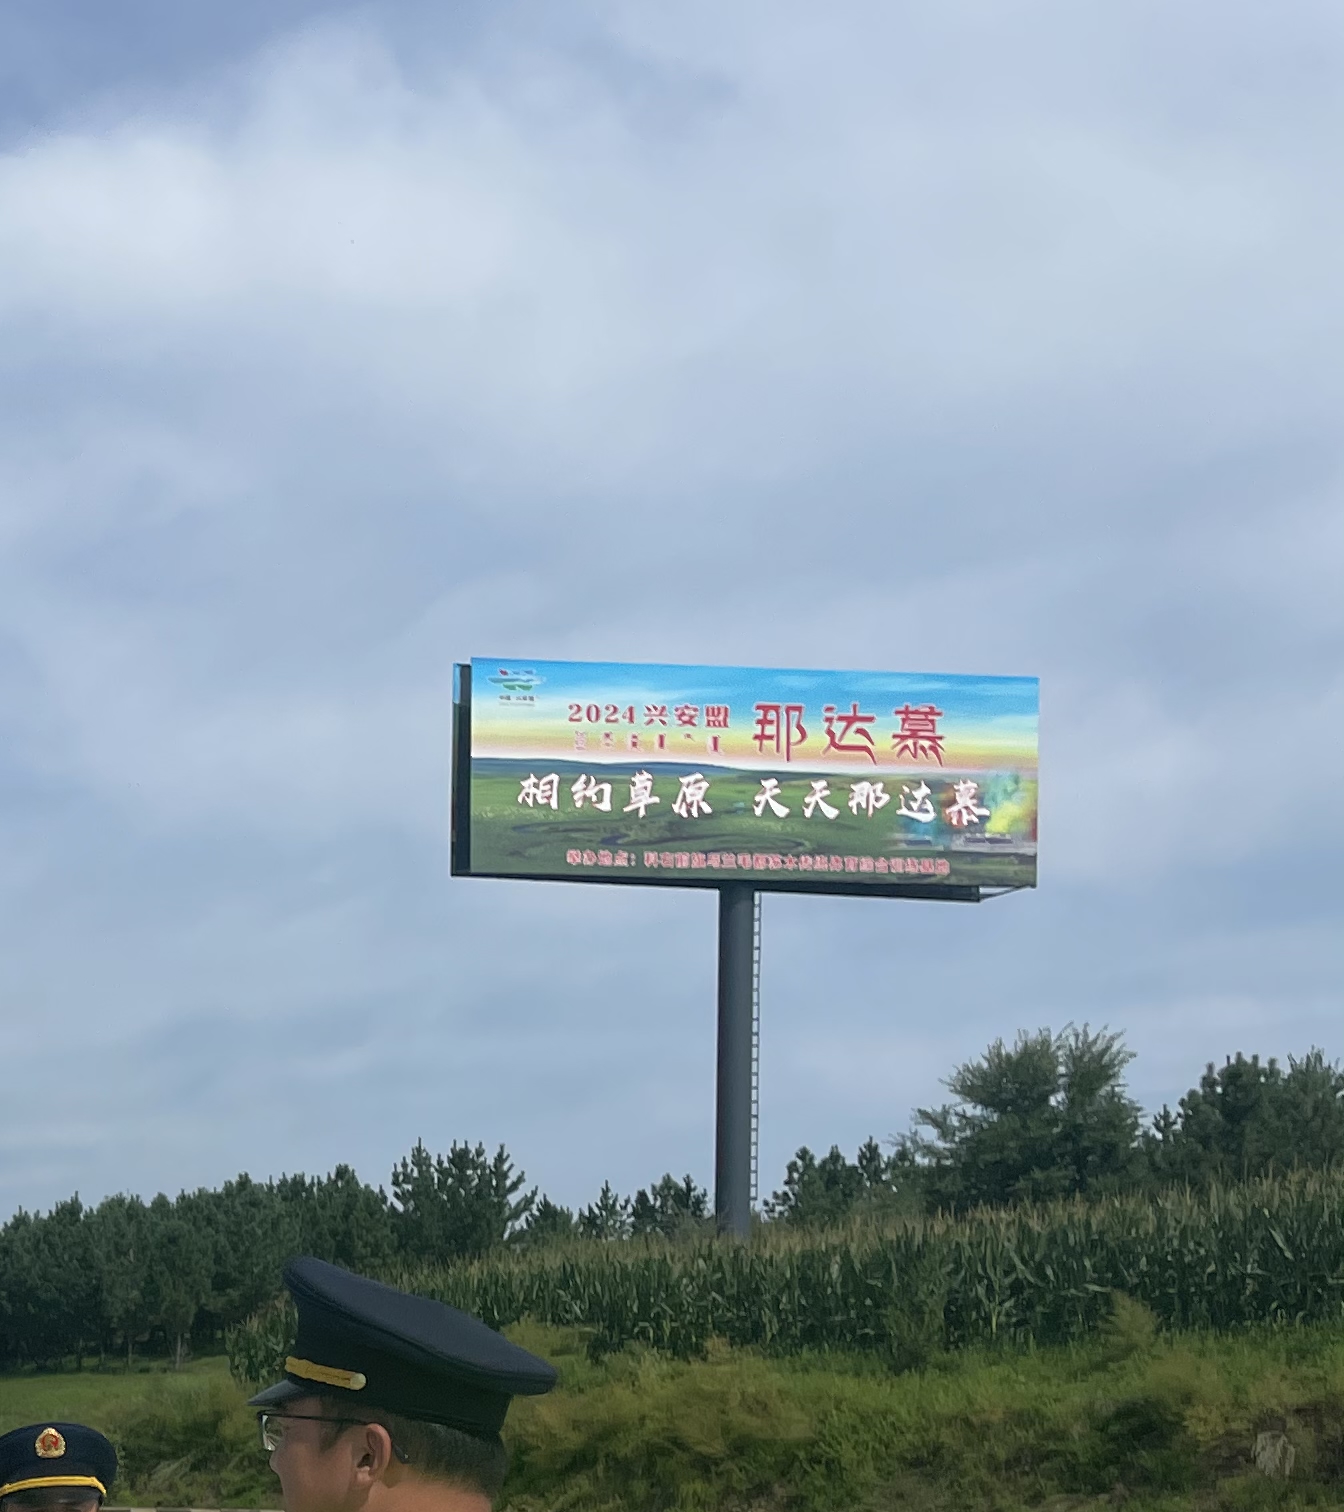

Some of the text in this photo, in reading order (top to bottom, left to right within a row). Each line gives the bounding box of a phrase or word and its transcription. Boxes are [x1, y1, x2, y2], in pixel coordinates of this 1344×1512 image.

[567, 703, 731, 729] 2024兴安盟
[753, 702, 946, 765] 那达慕
[517, 770, 991, 826] 相约草原 天天那达慕
